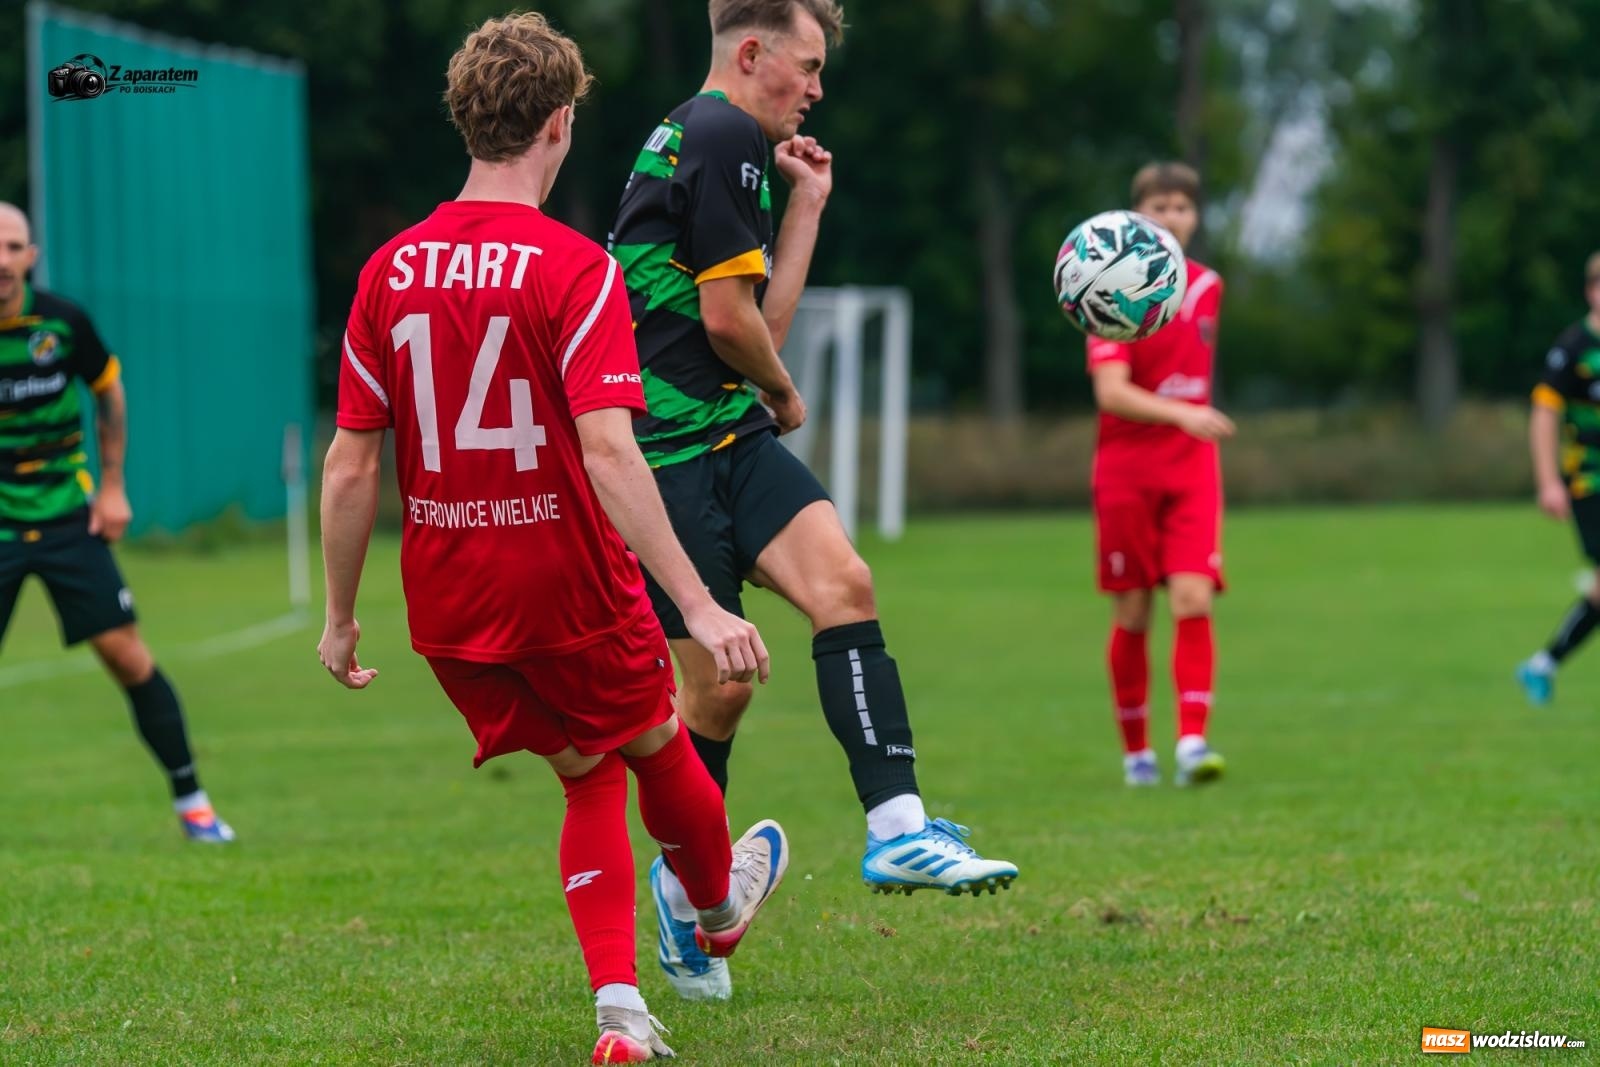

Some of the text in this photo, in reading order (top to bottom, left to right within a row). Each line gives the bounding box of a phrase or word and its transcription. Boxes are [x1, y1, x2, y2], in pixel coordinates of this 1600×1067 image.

[388, 241, 543, 291] START
[391, 313, 546, 473] 14
[408, 493, 560, 529] PETROWICE WIELKIE
